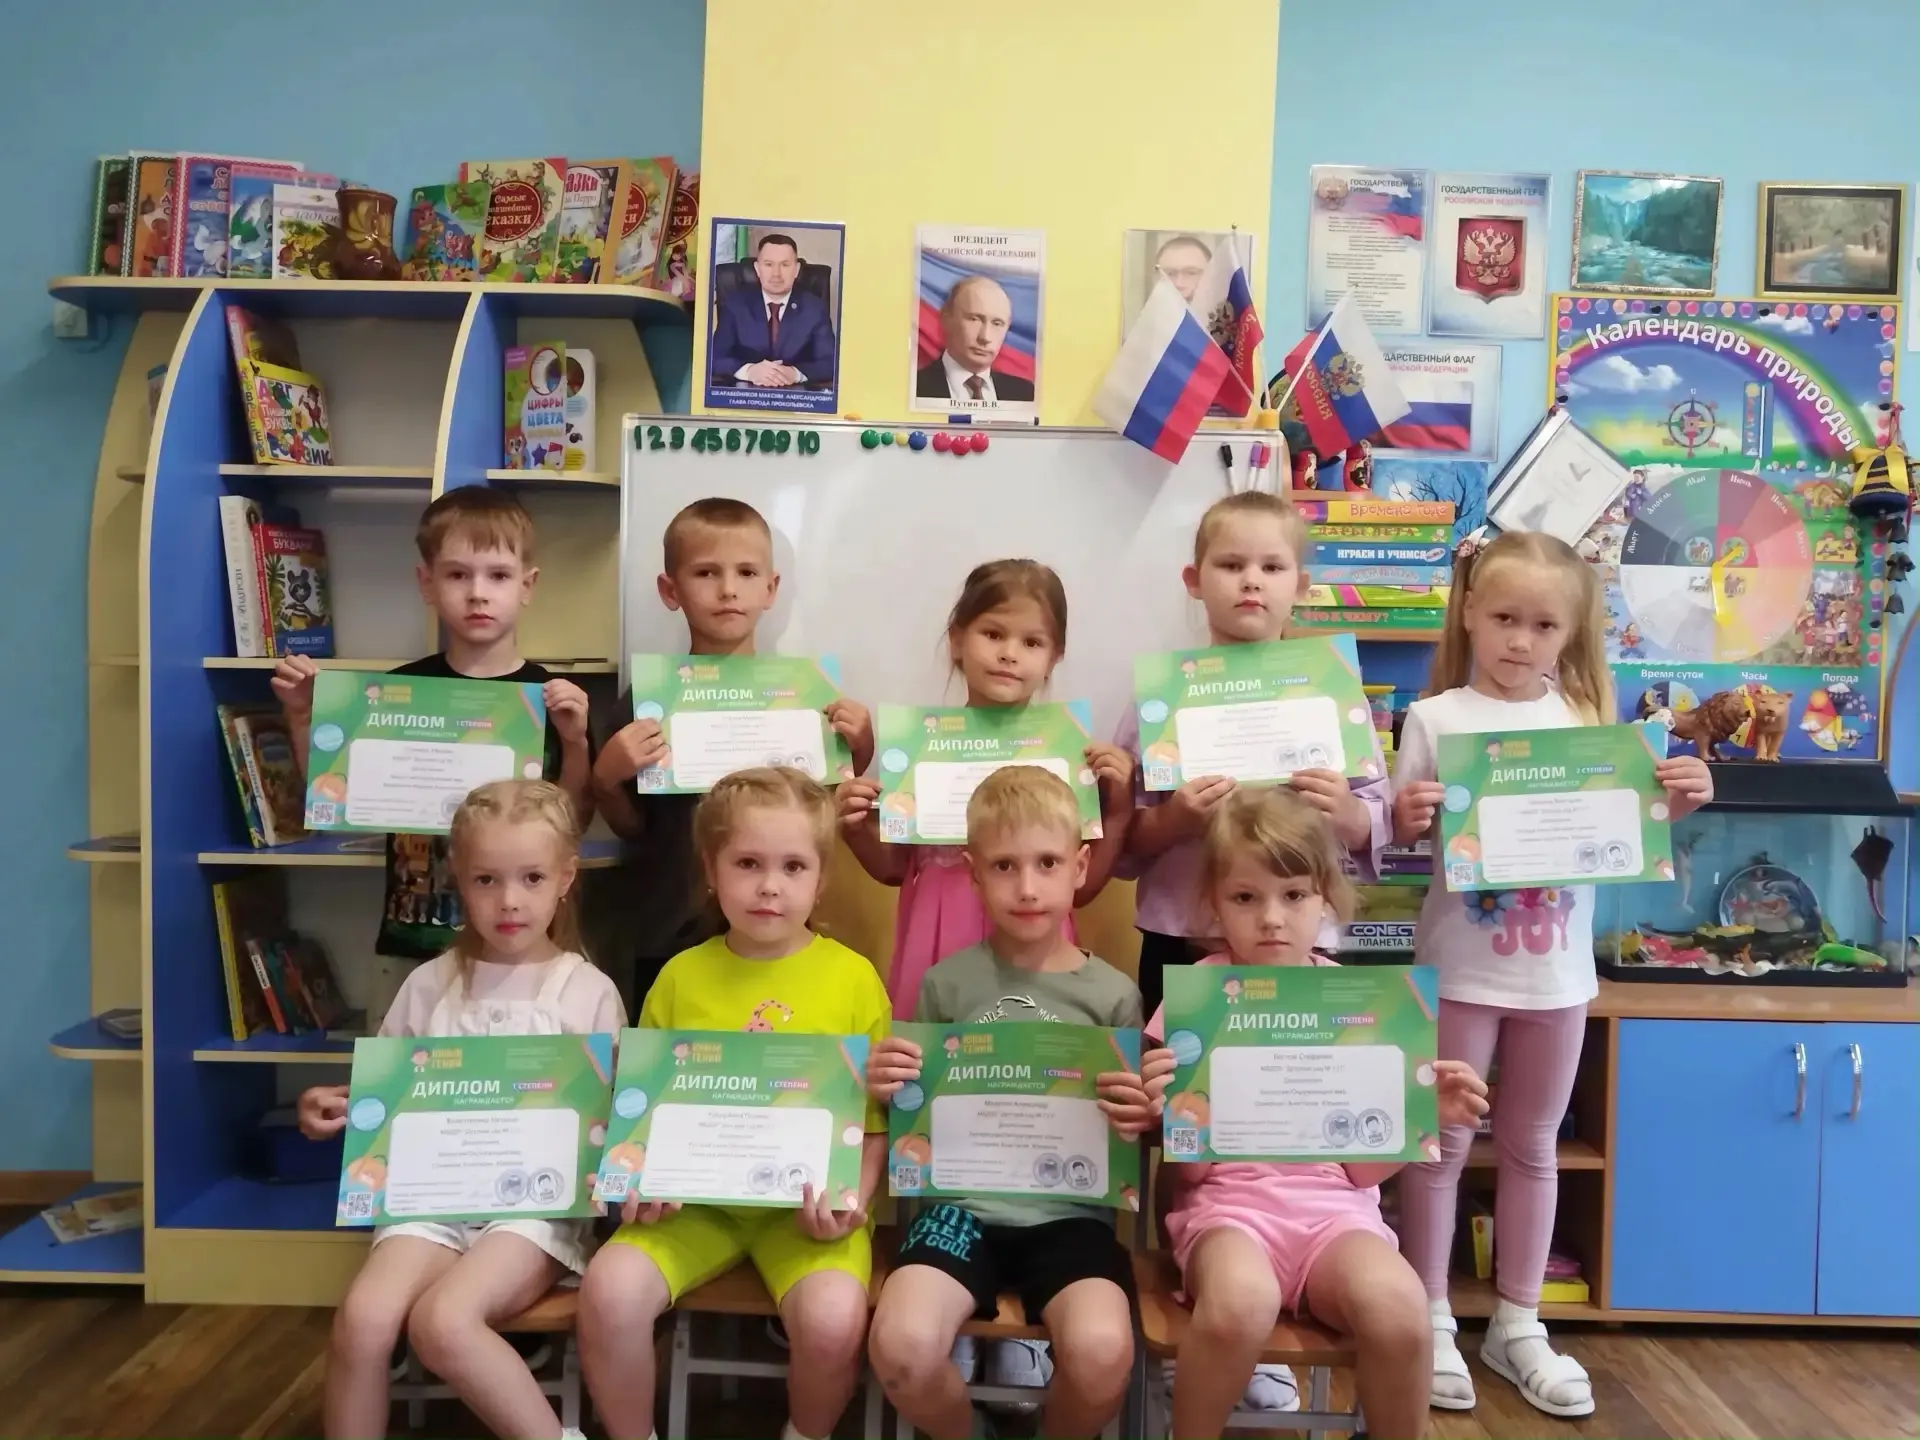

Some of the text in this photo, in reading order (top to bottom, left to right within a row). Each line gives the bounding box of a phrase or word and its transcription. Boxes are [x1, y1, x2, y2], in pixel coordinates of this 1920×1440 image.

[565, 172, 599, 193] азки
[1440, 185, 1522, 196] ГОСУДАРСТВЕННЫЙ
[953, 235, 1008, 245] ПРЕЗИДЕНТ
[1383, 353, 1476, 364] ДАРСТВЕННЫЙ ФЛАГ
[1586, 318, 1861, 452] Календарь природы
[949, 399, 979, 411] Путин
[527, 412, 564, 427] ЦВЕТА
[1350, 503, 1412, 517] Времена
[1647, 491, 1672, 515] Апрель
[1626, 530, 1639, 554] Март
[1337, 548, 1375, 559] ИГРАЕМ
[1387, 549, 1427, 560] УЧИМСЯ
[1641, 669, 1704, 682] Время суток
[1741, 671, 1768, 681] Часы
[1822, 672, 1859, 684] Погода
[683, 688, 753, 702] ДИПЛОМ
[1187, 679, 1262, 697] ДИПЛОМ
[366, 712, 445, 729] ДИПЛОМ
[928, 739, 1000, 752] ДИПЛОМ
[1491, 766, 1566, 784] ДИПЛОМ
[1359, 938, 1403, 947] ПЛАНЕТА
[1227, 1013, 1318, 1032] ДИПЛОМ
[1337, 1016, 1374, 1025] СТЕПЕНИ
[948, 1065, 1031, 1082] ДИПЛОМ
[412, 1080, 500, 1098] ДИПЛОМ
[672, 1074, 757, 1092] ДИПЛОМ
